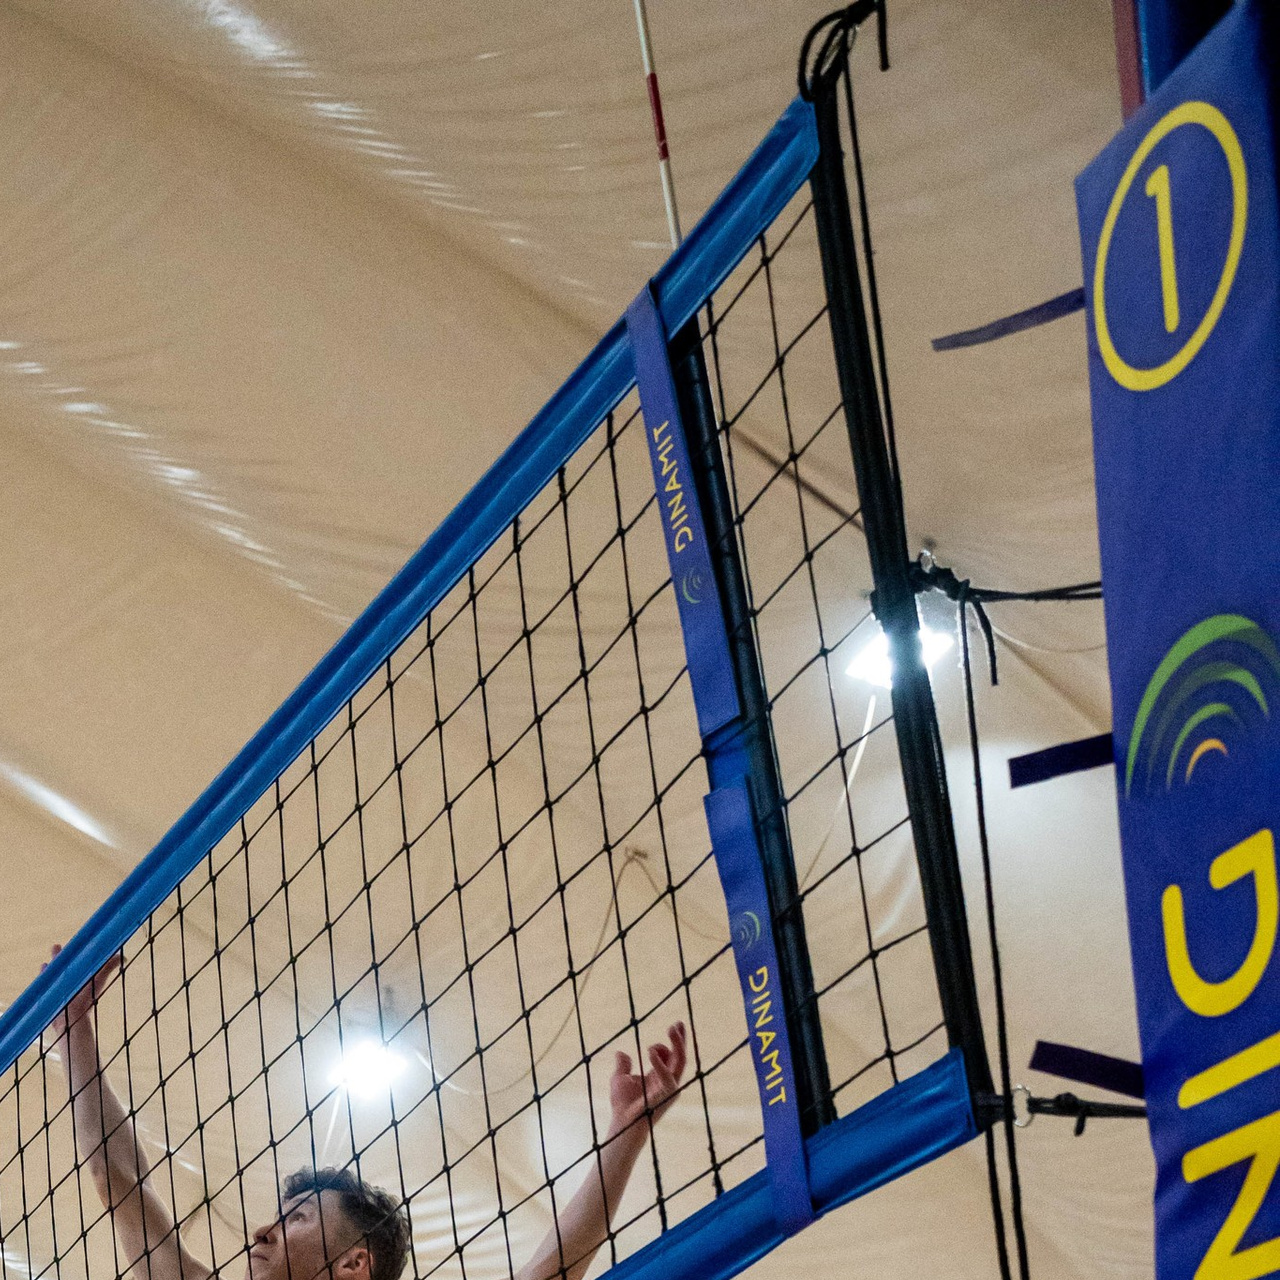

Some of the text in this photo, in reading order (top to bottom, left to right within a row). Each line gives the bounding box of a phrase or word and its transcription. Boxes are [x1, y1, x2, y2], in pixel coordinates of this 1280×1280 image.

[1145, 164, 1180, 334] 1
[651, 420, 694, 554] DINAMIT
[747, 965, 787, 1107] DINAMIT
